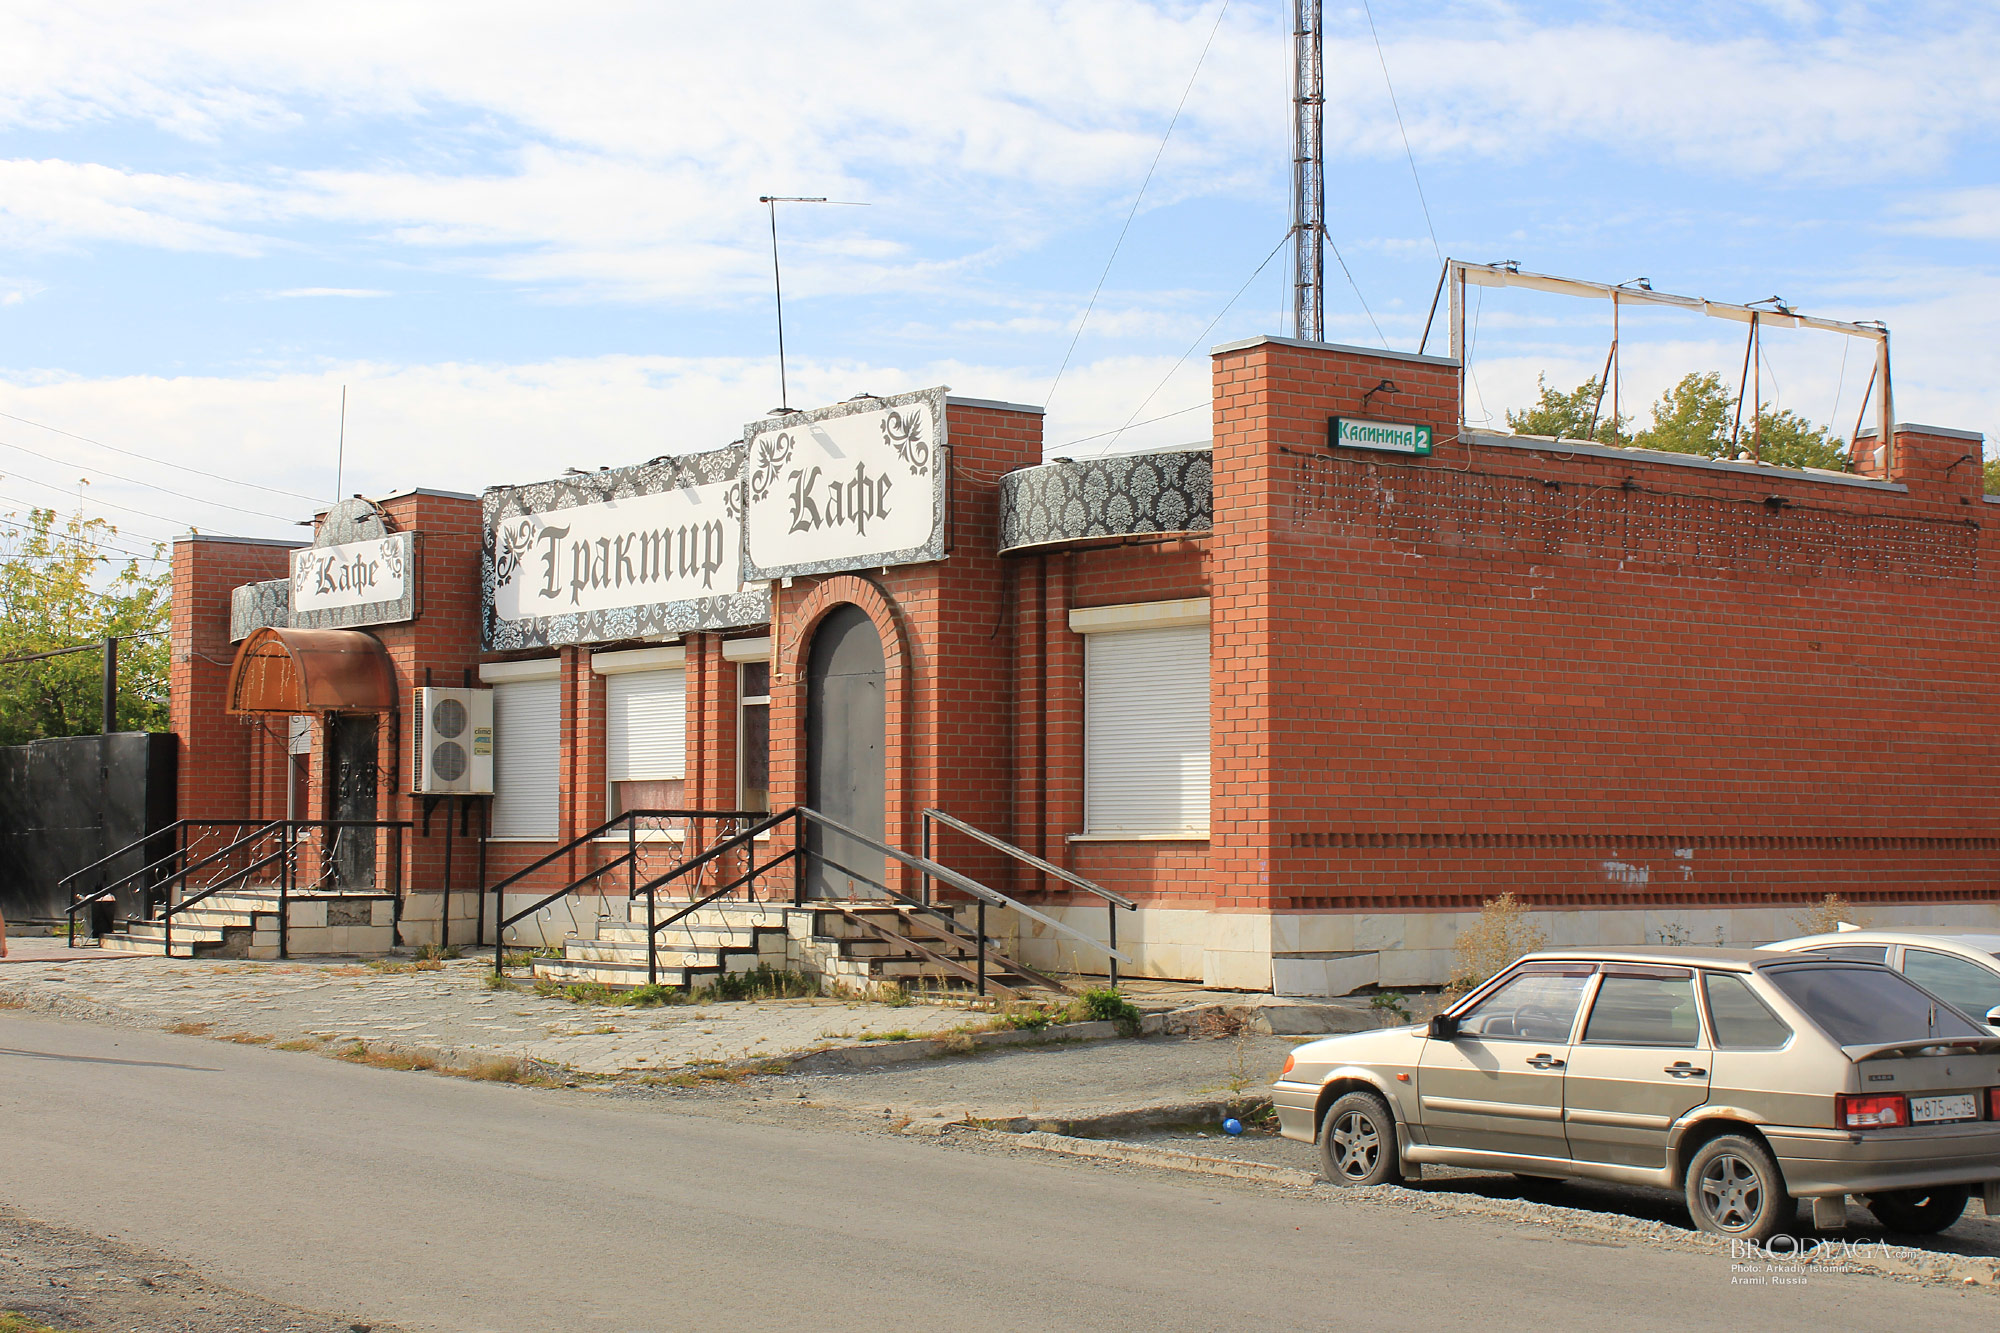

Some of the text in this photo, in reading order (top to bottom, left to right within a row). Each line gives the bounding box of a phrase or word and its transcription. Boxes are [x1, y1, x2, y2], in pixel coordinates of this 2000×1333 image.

[1417, 430, 1428, 449] 2
[787, 460, 893, 537] Кафе
[314, 552, 379, 597] Кафе
[536, 518, 724, 607] Трактир
